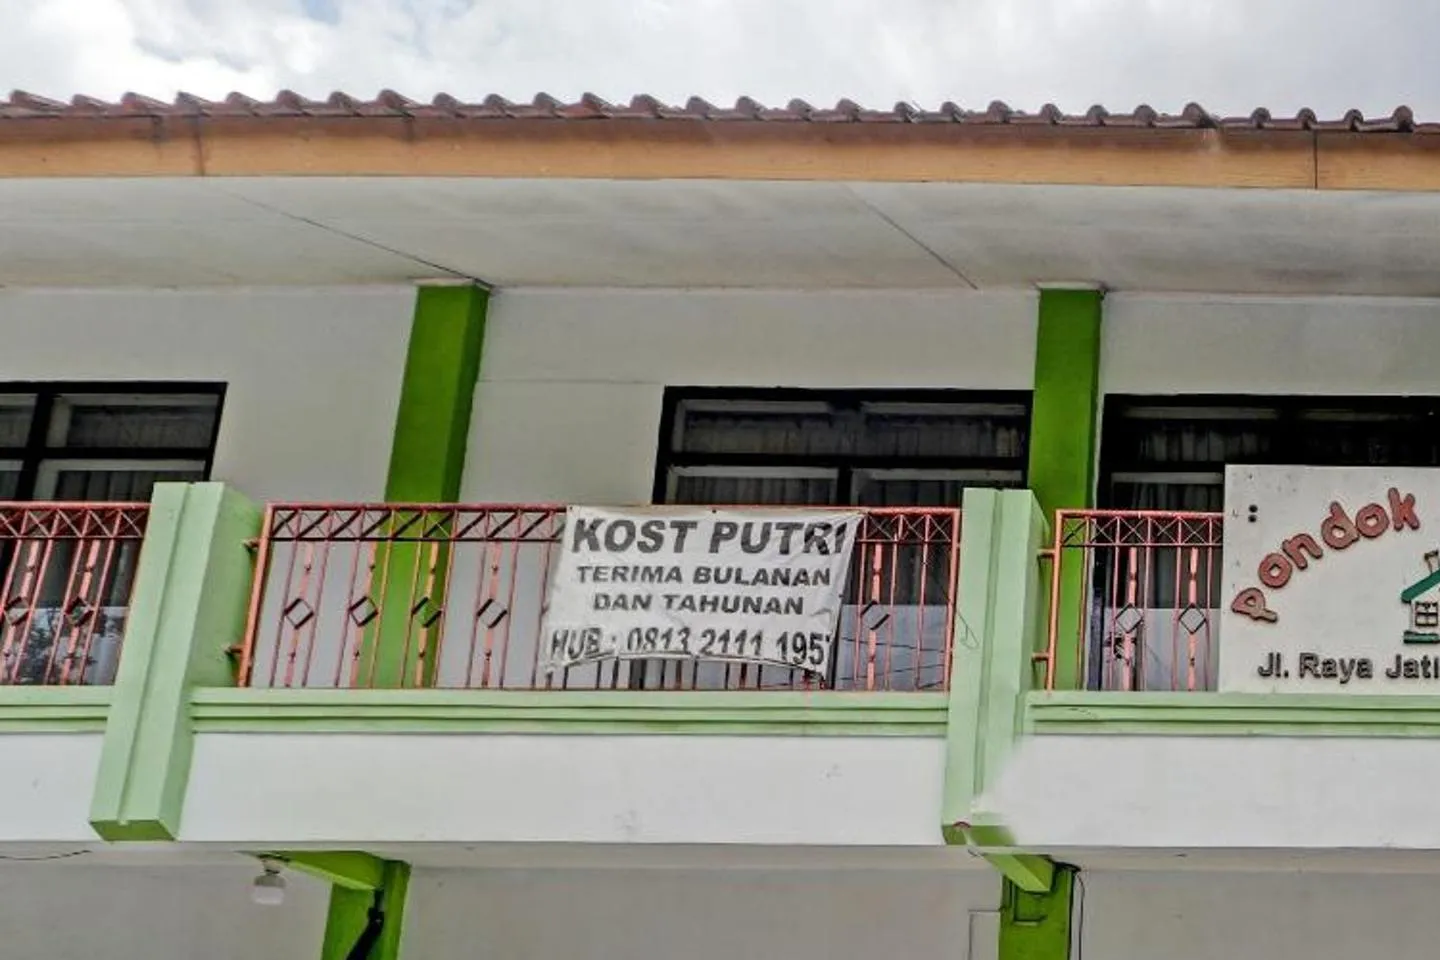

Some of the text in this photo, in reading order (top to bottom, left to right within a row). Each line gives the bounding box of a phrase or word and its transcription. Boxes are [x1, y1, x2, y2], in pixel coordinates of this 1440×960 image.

[571, 518, 848, 556] KOST PUTRI
[1231, 487, 1421, 624] Pondok
[576, 565, 831, 587] TERIMA BULANAN
[592, 593, 804, 615] DAN TAHUNAN
[700, 629, 763, 657] 2111
[776, 631, 833, 667] 195
[1299, 654, 1373, 684] Raya
